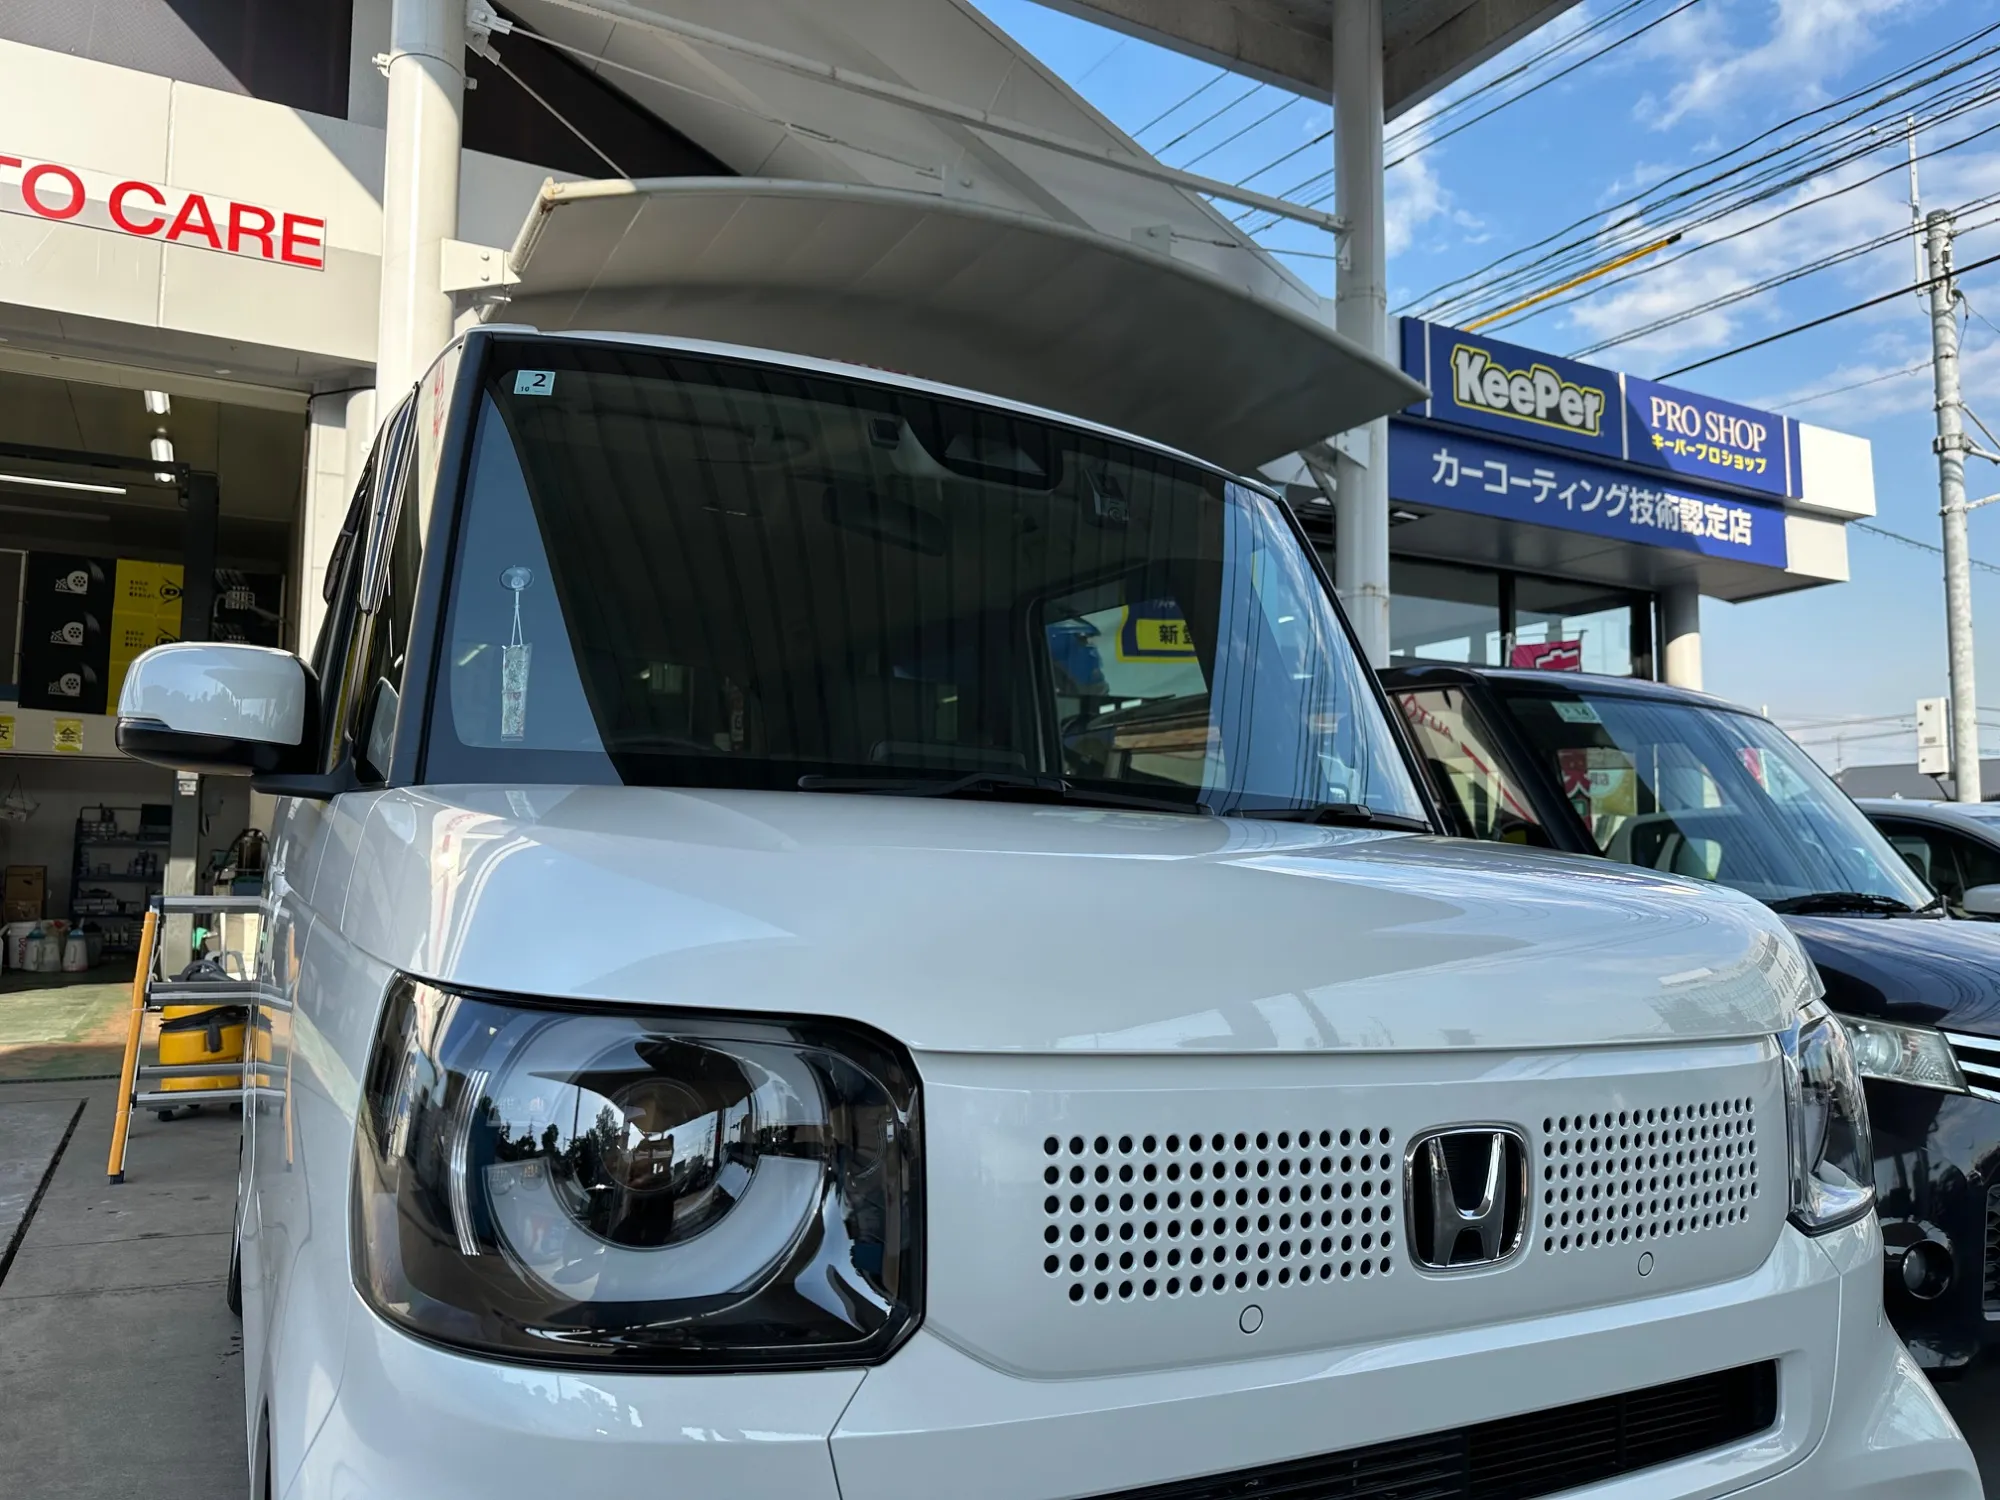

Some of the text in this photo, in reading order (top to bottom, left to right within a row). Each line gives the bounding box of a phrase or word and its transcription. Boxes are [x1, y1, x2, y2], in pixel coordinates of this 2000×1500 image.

[109, 181, 324, 267] CARE
[532, 373, 546, 387] 2
[1454, 347, 1603, 433] KeePer
[1650, 396, 1767, 452] PRO SHOP
[1432, 448, 1752, 546] カーコーティング技術認定店
[60, 727, 78, 742] 全
